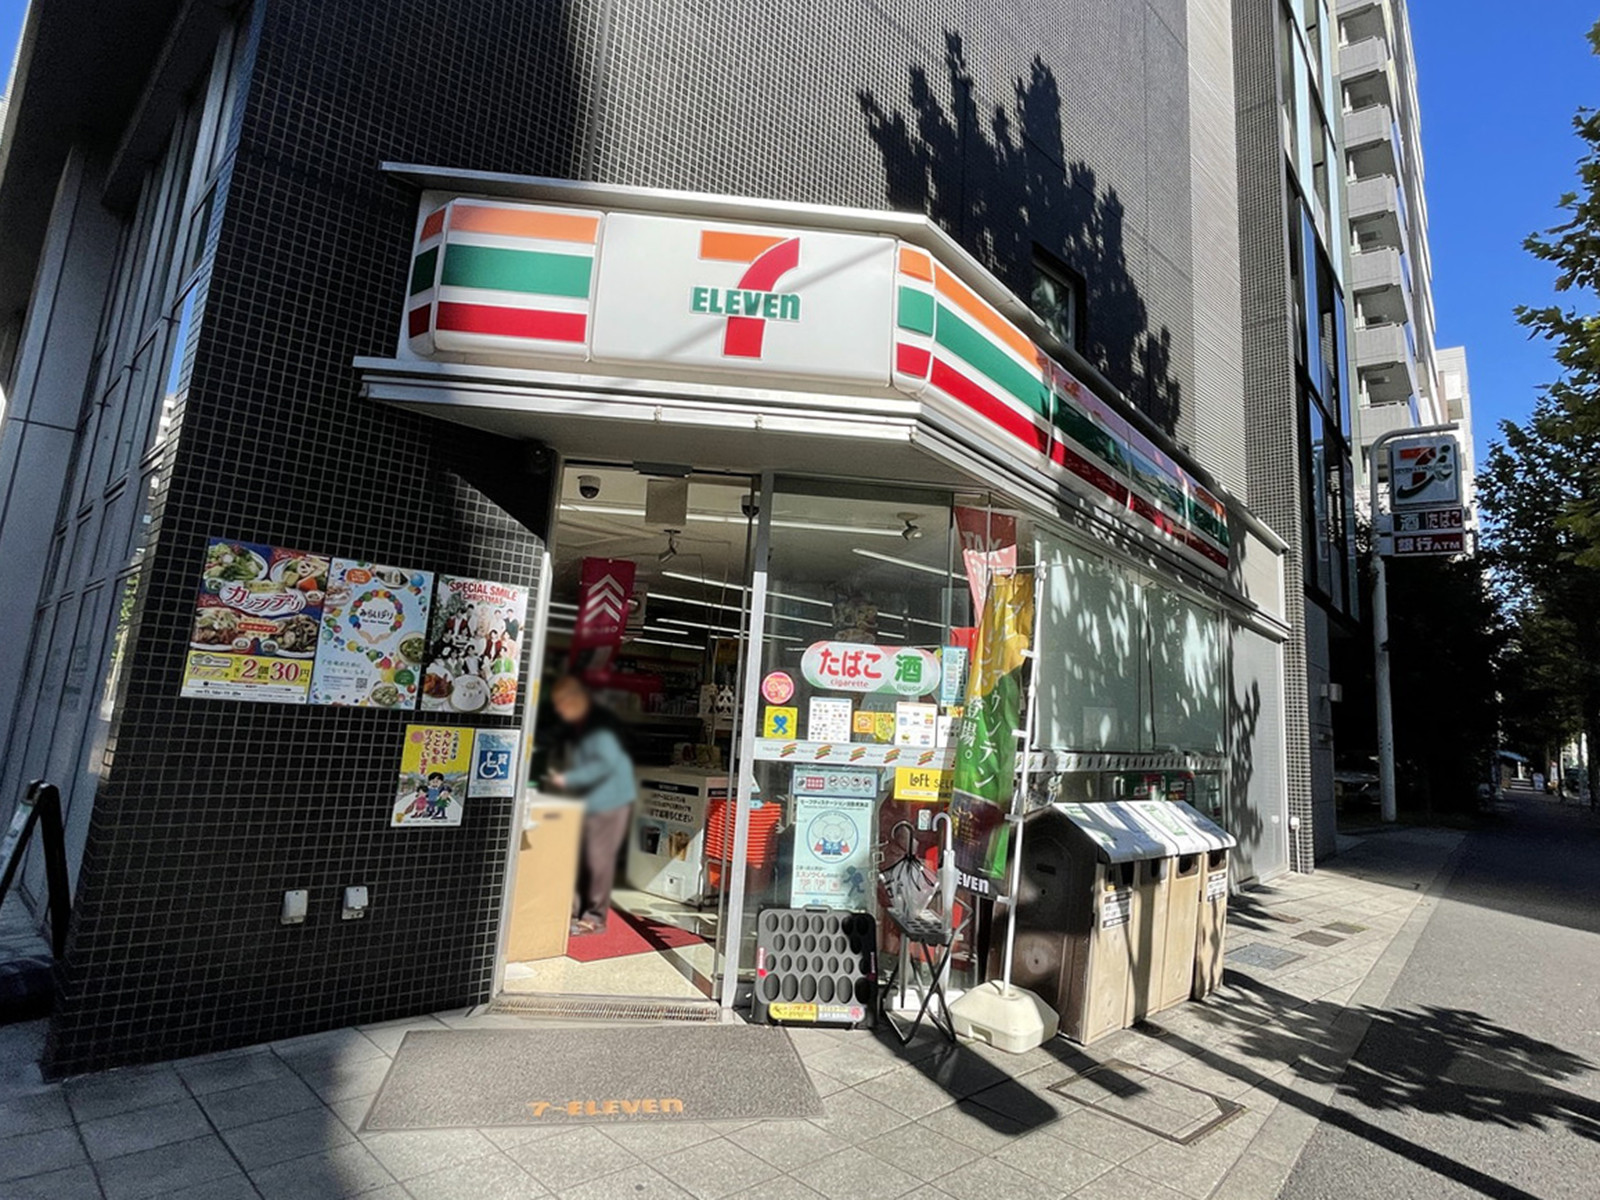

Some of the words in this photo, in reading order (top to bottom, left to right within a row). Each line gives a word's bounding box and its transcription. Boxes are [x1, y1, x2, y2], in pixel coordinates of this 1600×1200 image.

[699, 230, 801, 358] 7
[1400, 513, 1420, 530] 酒
[1427, 511, 1462, 529] たばこ
[449, 580, 488, 594] SPECIAL
[490, 586, 518, 601] SMILE
[462, 593, 504, 605] CHRISTMAS
[818, 648, 882, 679] たばこ
[894, 654, 923, 683] 酒
